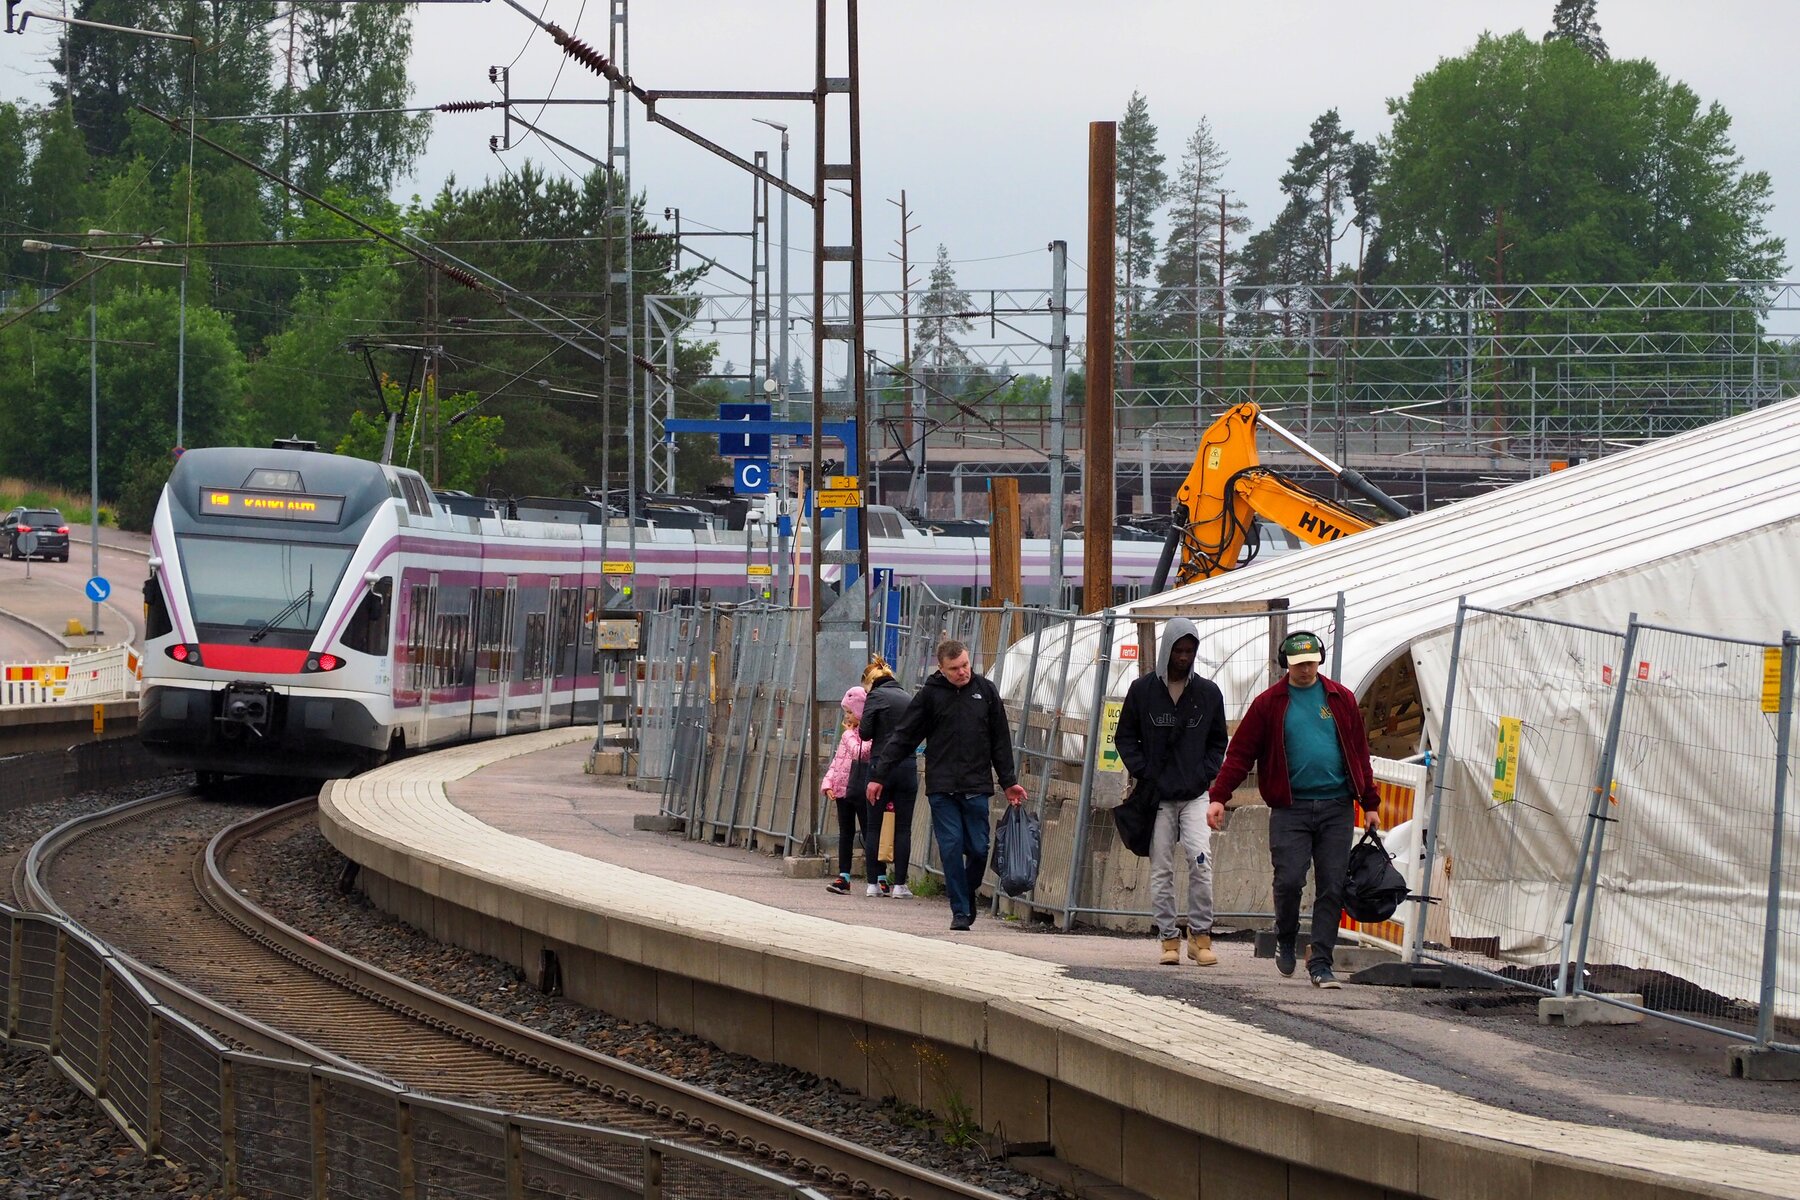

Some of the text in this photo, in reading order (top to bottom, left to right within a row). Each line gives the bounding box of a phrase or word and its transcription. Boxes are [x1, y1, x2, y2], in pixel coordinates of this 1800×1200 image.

[738, 413, 750, 447] 1
[742, 464, 762, 488] C
[1122, 648, 1136, 657] renta
[1108, 708, 1121, 718] ULO
